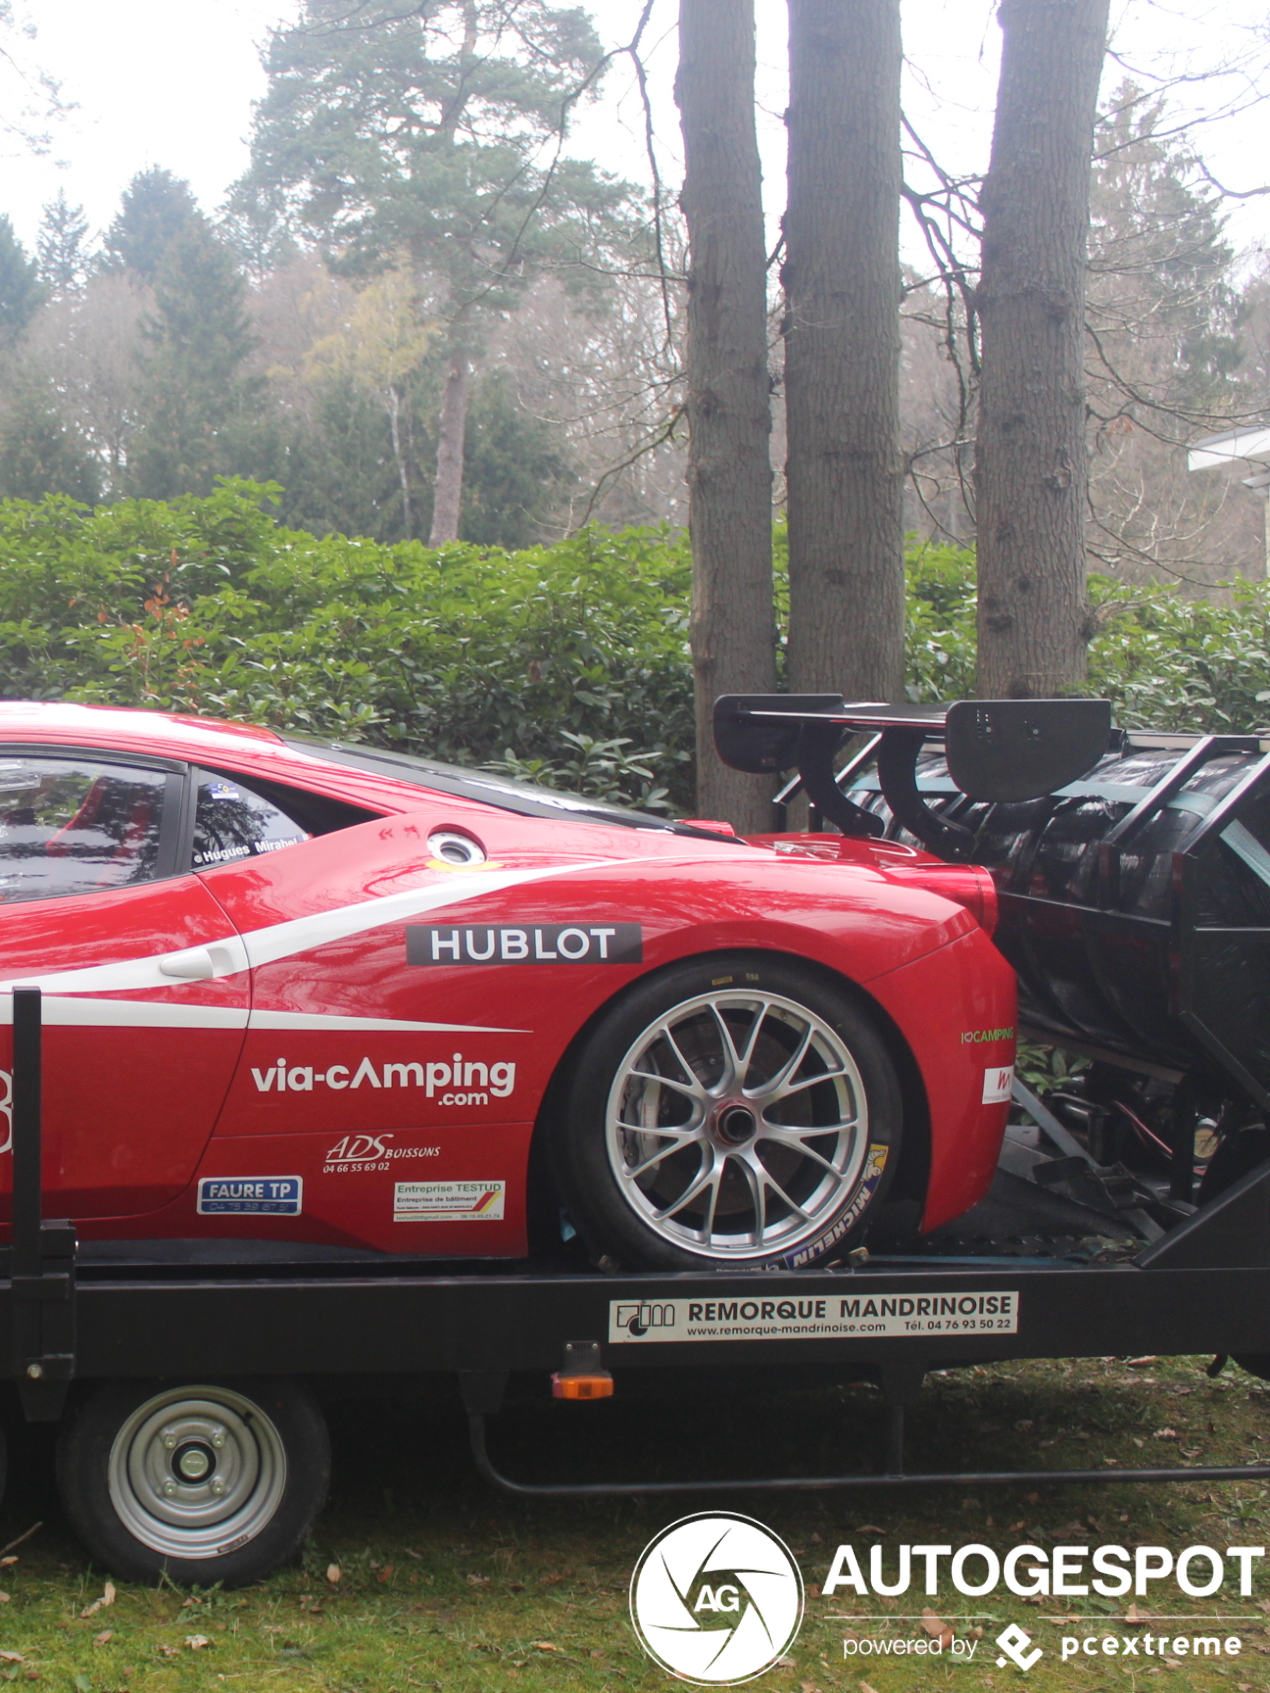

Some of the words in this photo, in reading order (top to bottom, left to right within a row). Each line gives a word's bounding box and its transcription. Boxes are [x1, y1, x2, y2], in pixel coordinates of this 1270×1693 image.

[203, 844, 250, 862] Hugues
[431, 928, 616, 960] HUBLOT
[973, 1027, 1014, 1043] CAMPING
[438, 1092, 488, 1106] .com
[325, 1133, 394, 1162] ADS
[385, 1147, 441, 1159] BOISSONS
[323, 1165, 335, 1173] 04
[337, 1164, 349, 1172] 66
[351, 1163, 362, 1172] 55
[364, 1163, 376, 1171] 69
[378, 1162, 390, 1171] 02
[210, 1184, 264, 1198] FAURE
[269, 1183, 291, 1198] TP
[397, 1184, 452, 1194] Entreprise
[456, 1183, 501, 1192] TESTUD
[228, 1202, 241, 1211] 75
[793, 1186, 871, 1268] MICHELIN
[688, 1301, 826, 1321] REMORQUE
[840, 1296, 1011, 1318] MANDRINOISE
[687, 1322, 886, 1336] www.remorque-mandrinoise.com
[905, 1320, 924, 1331] Tél.
[928, 1321, 941, 1330] 04
[945, 1320, 959, 1330] 76
[962, 1320, 976, 1329] 93
[980, 1319, 993, 1329] 50
[997, 1319, 1011, 1329] 22
